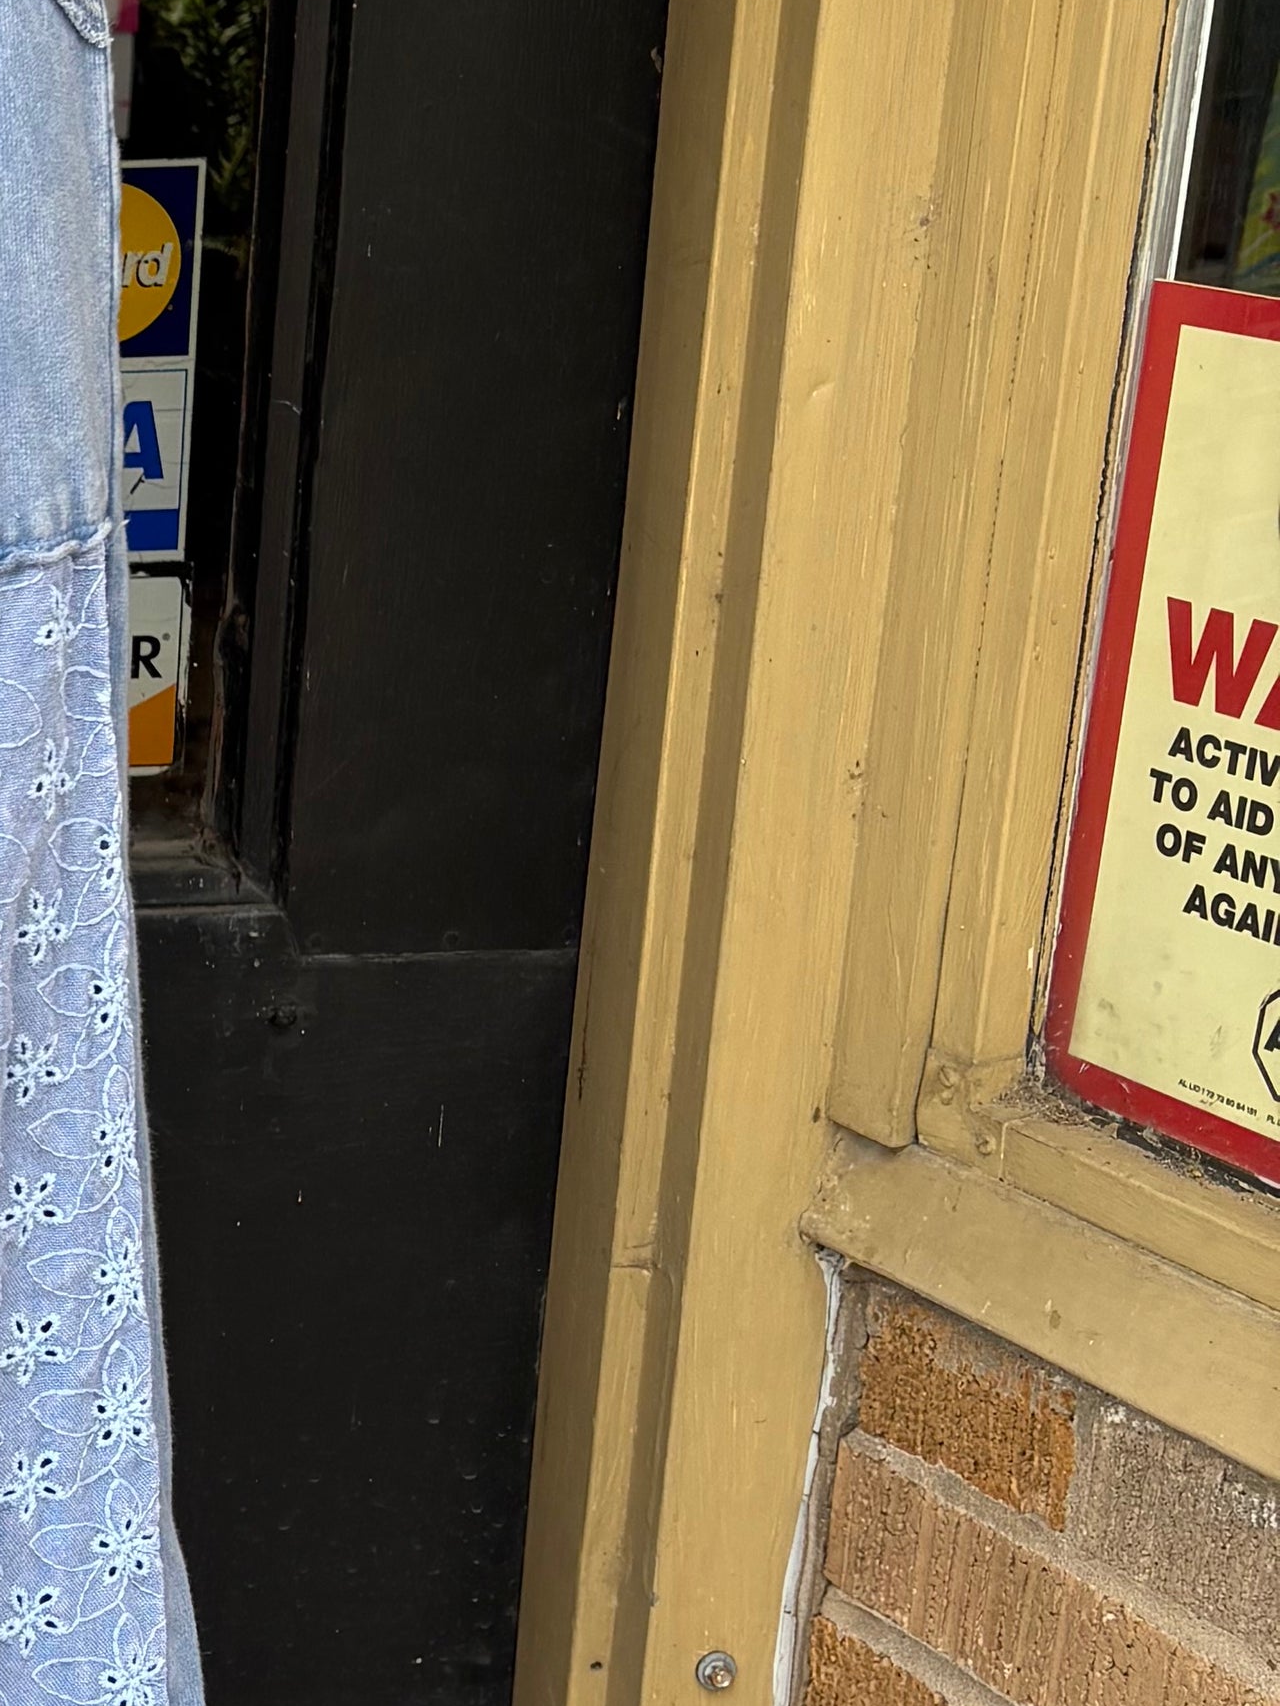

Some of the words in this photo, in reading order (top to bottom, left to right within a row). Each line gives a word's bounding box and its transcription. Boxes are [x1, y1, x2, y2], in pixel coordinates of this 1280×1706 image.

[1167, 596, 1280, 731] W
[1149, 768, 1198, 812] TO
[1207, 789, 1274, 836] AID
[1156, 823, 1207, 864] OF
[1182, 884, 1280, 948] AGAI
